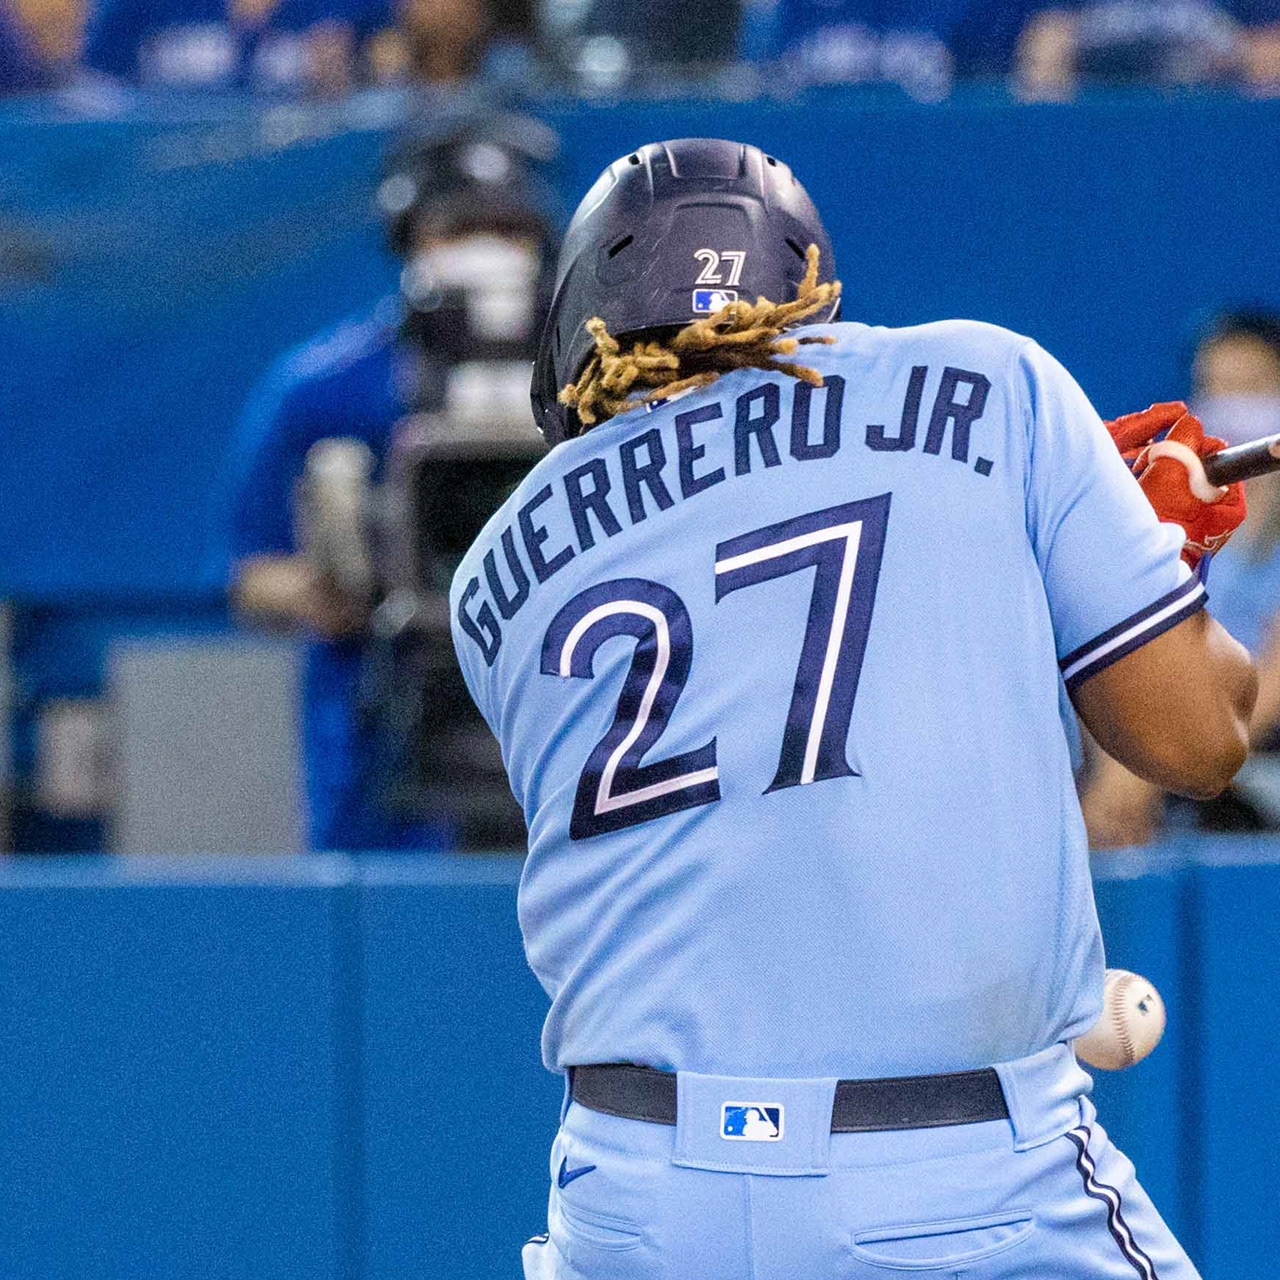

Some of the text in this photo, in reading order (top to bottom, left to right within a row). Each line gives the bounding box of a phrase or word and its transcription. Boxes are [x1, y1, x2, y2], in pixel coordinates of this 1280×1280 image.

[694, 248, 747, 287] 27
[457, 365, 995, 668] GUERRERO JR.
[539, 491, 893, 841] 27
